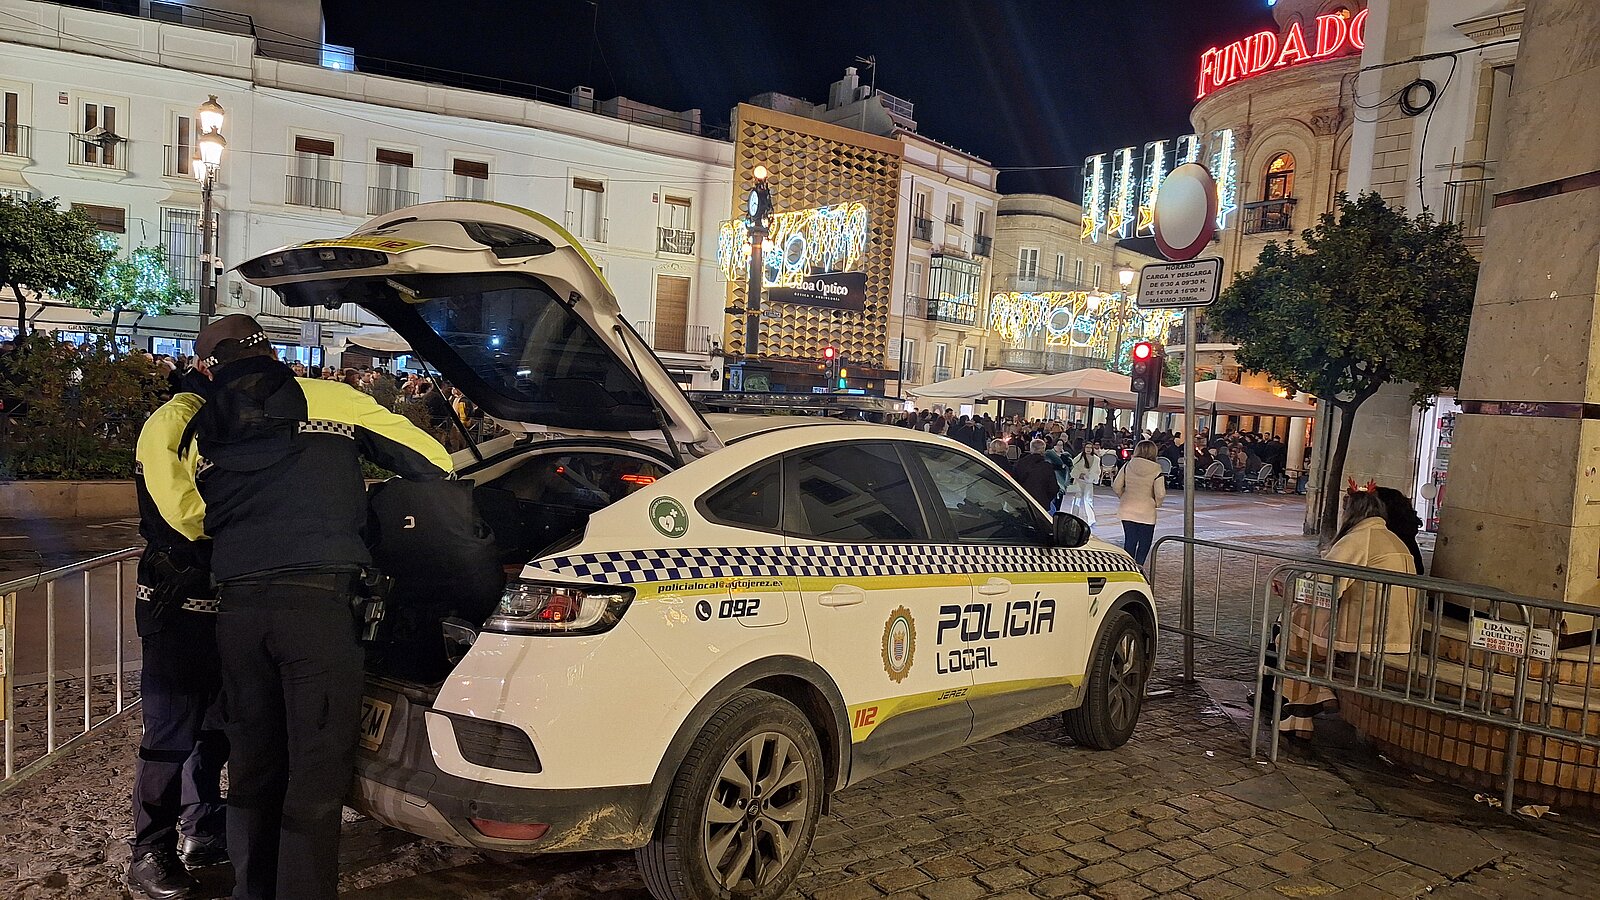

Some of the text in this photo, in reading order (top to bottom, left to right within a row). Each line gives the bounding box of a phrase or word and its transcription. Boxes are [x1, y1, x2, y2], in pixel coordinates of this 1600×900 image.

[1176, 269, 1212, 278] DESCARGA
[816, 279, 849, 296] Optico
[657, 580, 783, 593] policialocal@aytojerez.es
[718, 599, 760, 619] 092
[936, 591, 1056, 645] POLICÍA
[936, 646, 998, 674] LOCAL
[937, 688, 968, 701] JEREZ
[853, 706, 878, 729] 112
